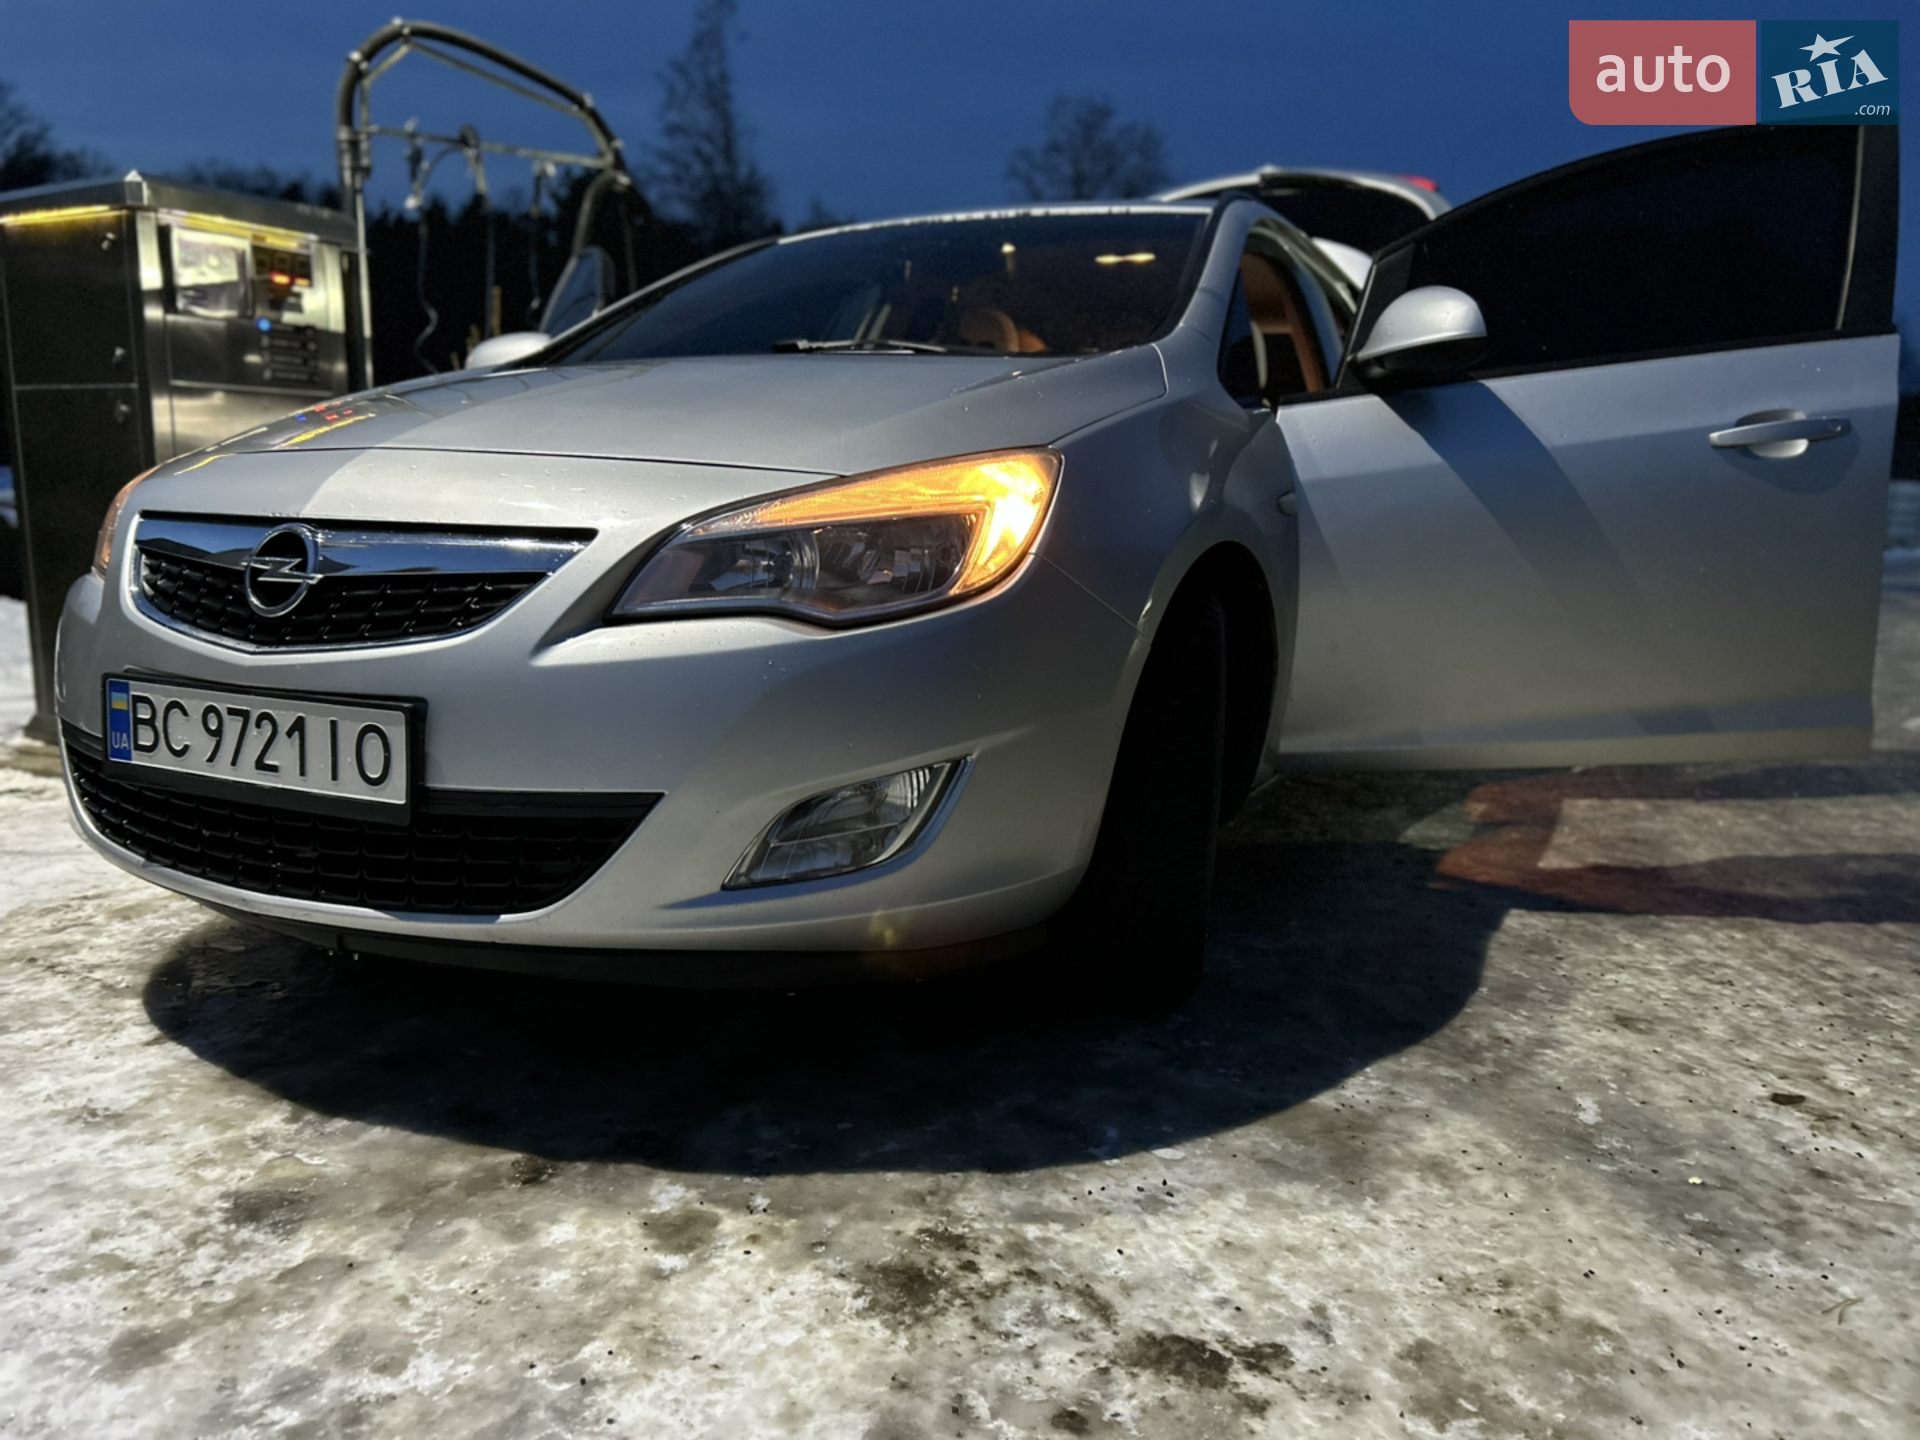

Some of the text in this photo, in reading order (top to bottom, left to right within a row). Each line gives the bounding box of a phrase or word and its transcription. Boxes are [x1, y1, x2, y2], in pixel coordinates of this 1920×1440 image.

[111, 731, 130, 750] UA
[131, 693, 391, 787] BC 9721 IO
